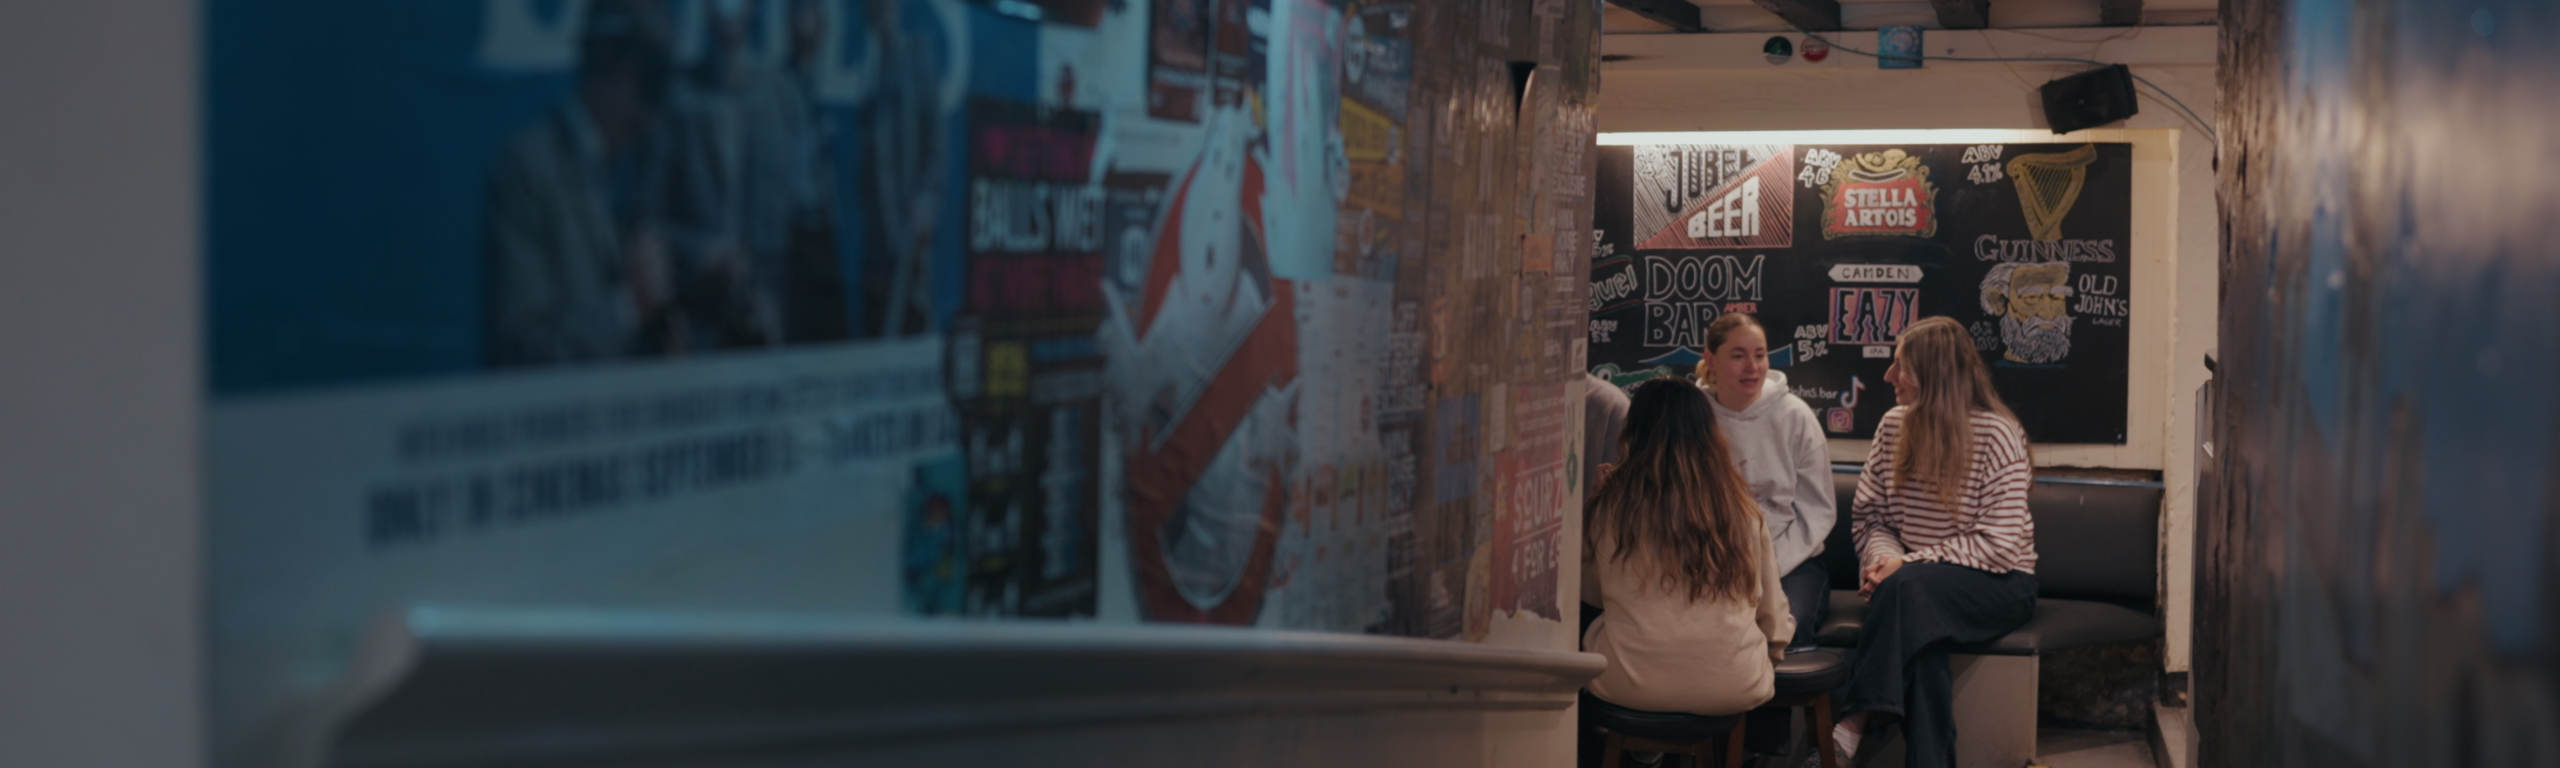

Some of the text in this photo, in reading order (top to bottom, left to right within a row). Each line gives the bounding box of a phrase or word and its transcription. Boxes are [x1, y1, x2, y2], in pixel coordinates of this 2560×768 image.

[1804, 148, 1842, 169] ABV
[1961, 145, 2003, 164] ABV
[1665, 150, 1755, 214] JUBEL
[1687, 175, 1760, 238] BEER
[1844, 188, 1918, 208] STELLA
[1844, 208, 1918, 228] ARTOIS
[1974, 234, 2116, 263] GUINNESS
[1643, 255, 1765, 301] DOOM
[1842, 267, 1909, 280] CAMDEN
[2078, 274, 2118, 296] OLD
[1723, 301, 1758, 314] AMBER
[1836, 288, 1918, 343] EAZY
[2074, 294, 2128, 316] JOHN'S
[1643, 301, 1720, 347] BAR
[1794, 323, 1829, 340] ABV
[1797, 340, 1829, 362] 5%
[1513, 468, 1563, 534] SOURZ
[1523, 539, 1545, 582] FOR
